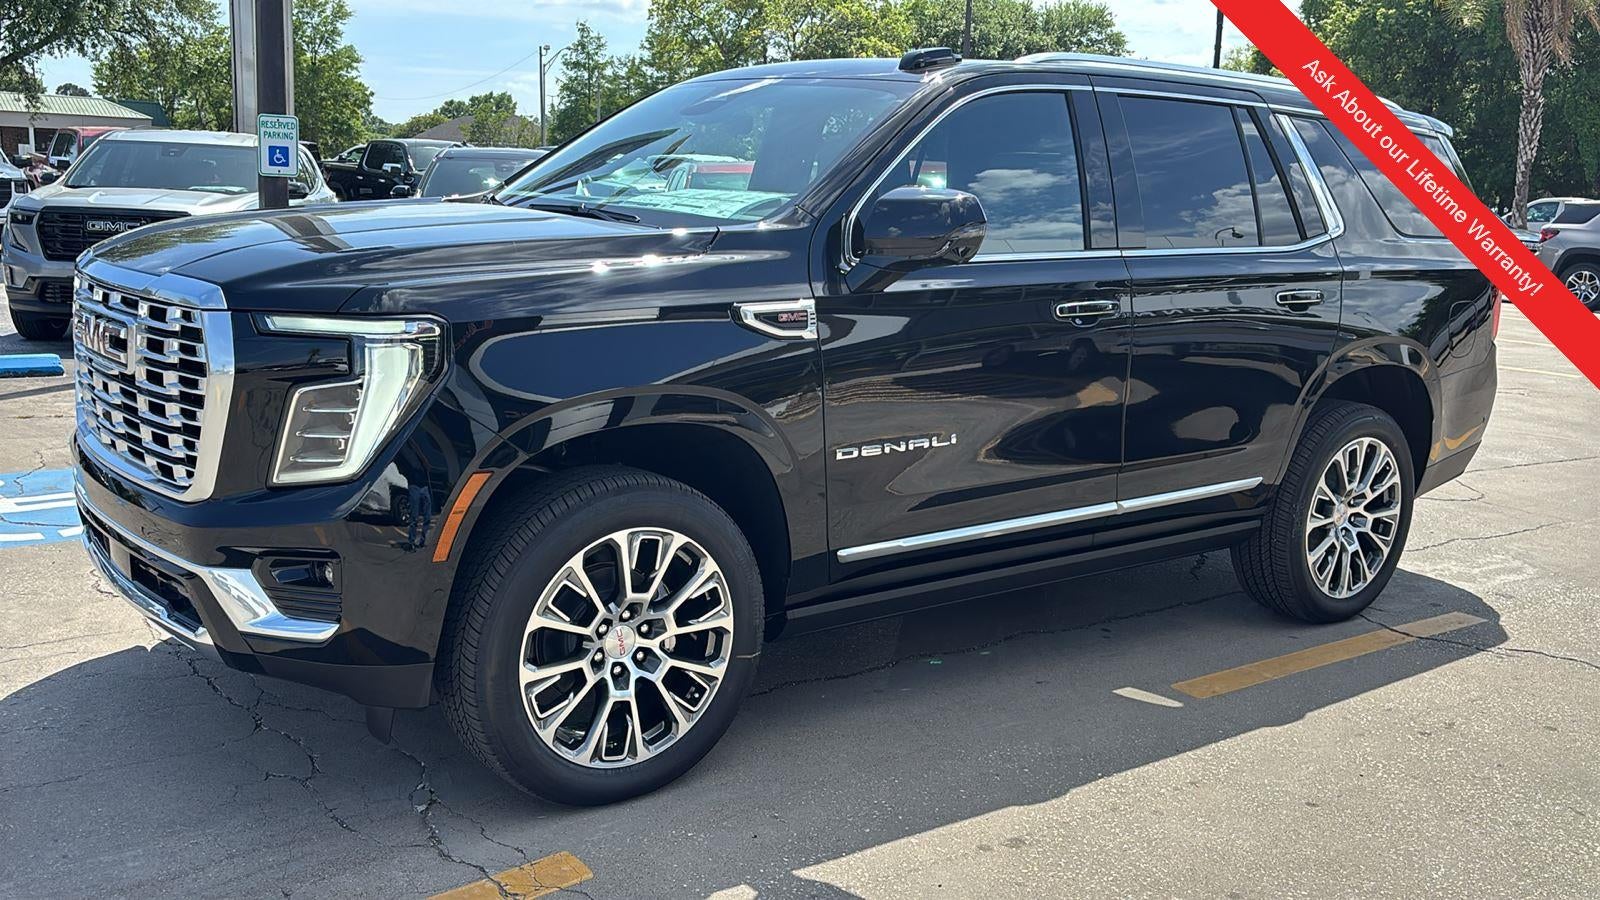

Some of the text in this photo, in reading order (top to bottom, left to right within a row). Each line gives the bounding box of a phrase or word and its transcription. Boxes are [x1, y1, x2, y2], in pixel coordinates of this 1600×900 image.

[260, 120, 296, 130] RESERVED
[263, 131, 294, 140] PARKING
[86, 220, 140, 232] GMC
[777, 312, 807, 322] GMC
[836, 433, 957, 461] DENALI
[616, 627, 626, 656] GMC
